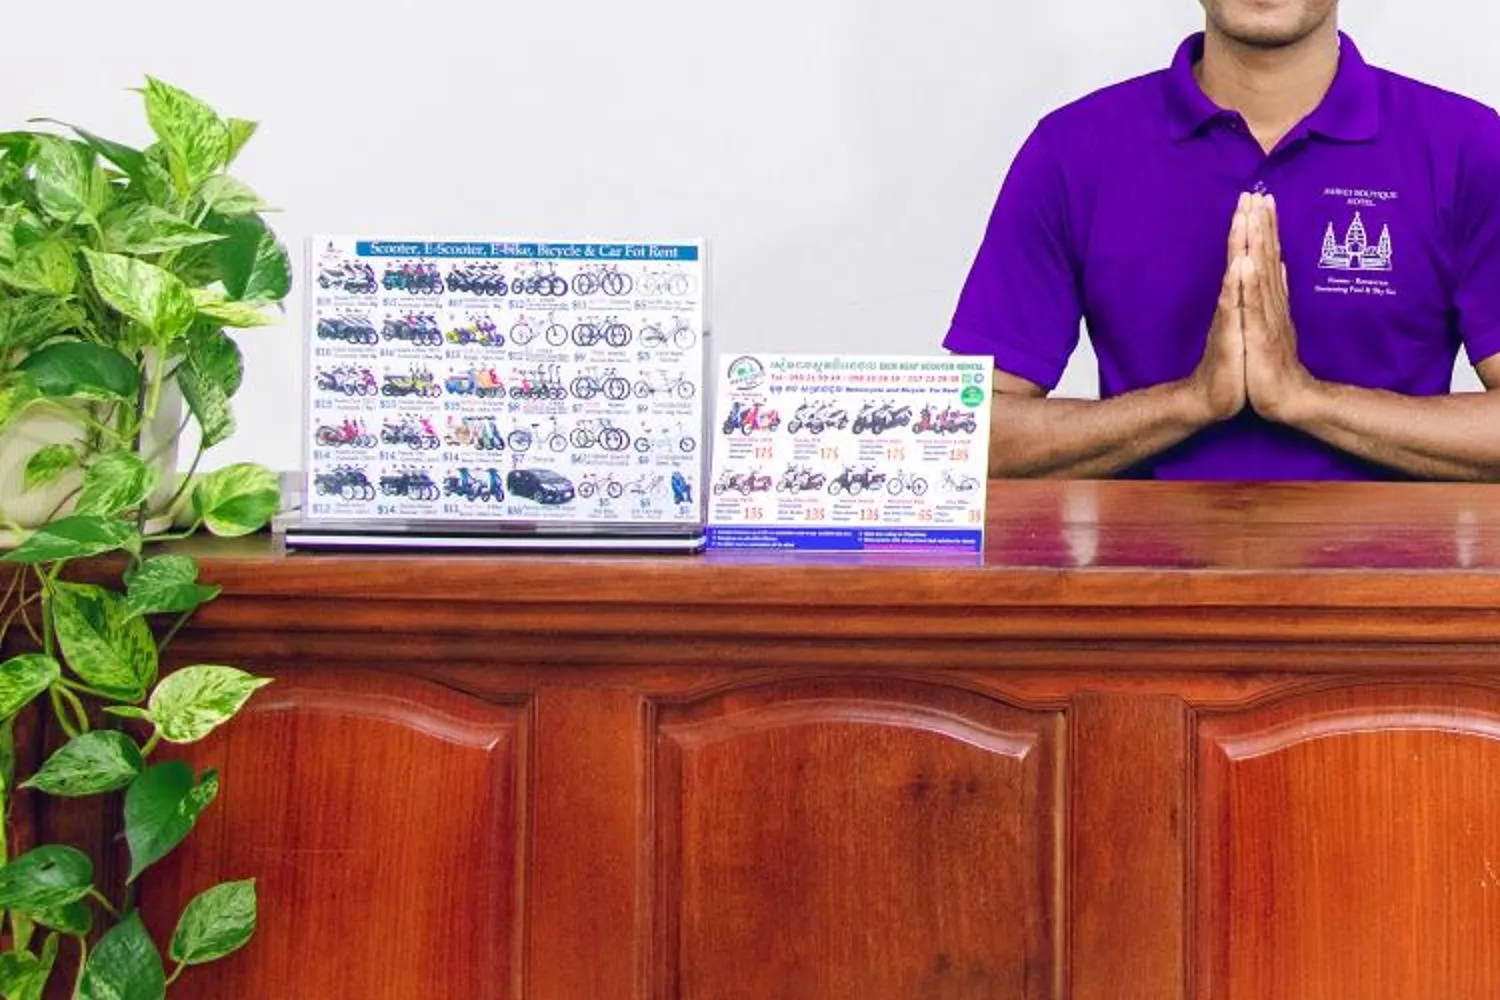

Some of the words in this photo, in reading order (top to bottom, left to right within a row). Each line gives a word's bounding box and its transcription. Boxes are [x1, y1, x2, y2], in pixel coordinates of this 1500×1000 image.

[370, 241, 422, 255] Scooter,
[425, 242, 488, 256] E-Scooter,
[537, 243, 581, 258] Bicycle
[583, 244, 595, 257] &
[599, 245, 622, 257] Car
[649, 246, 678, 257] Rent
